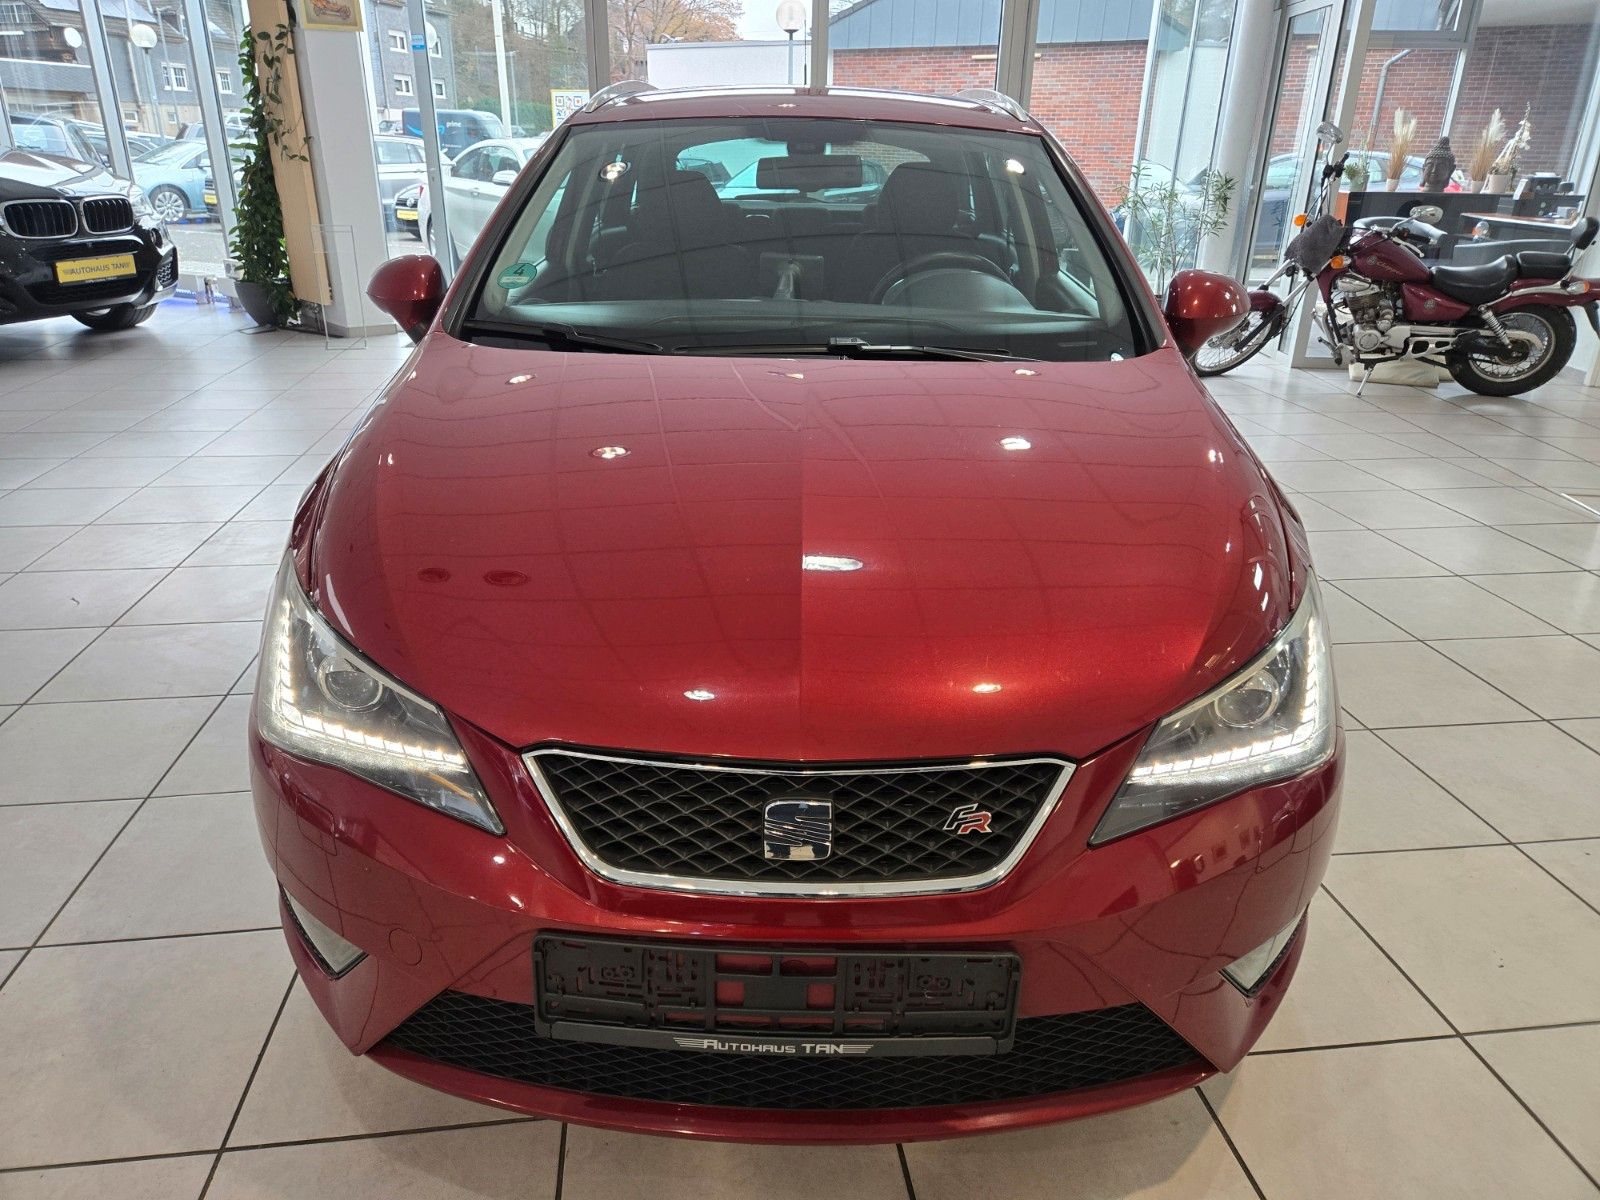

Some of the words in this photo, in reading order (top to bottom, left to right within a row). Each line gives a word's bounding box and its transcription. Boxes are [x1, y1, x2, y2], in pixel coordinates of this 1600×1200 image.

[446, 120, 461, 128] prime
[71, 264, 110, 275] AUTOHAUS
[513, 264, 525, 276] 4
[942, 803, 992, 835] FR
[801, 1043, 844, 1054] TAN
